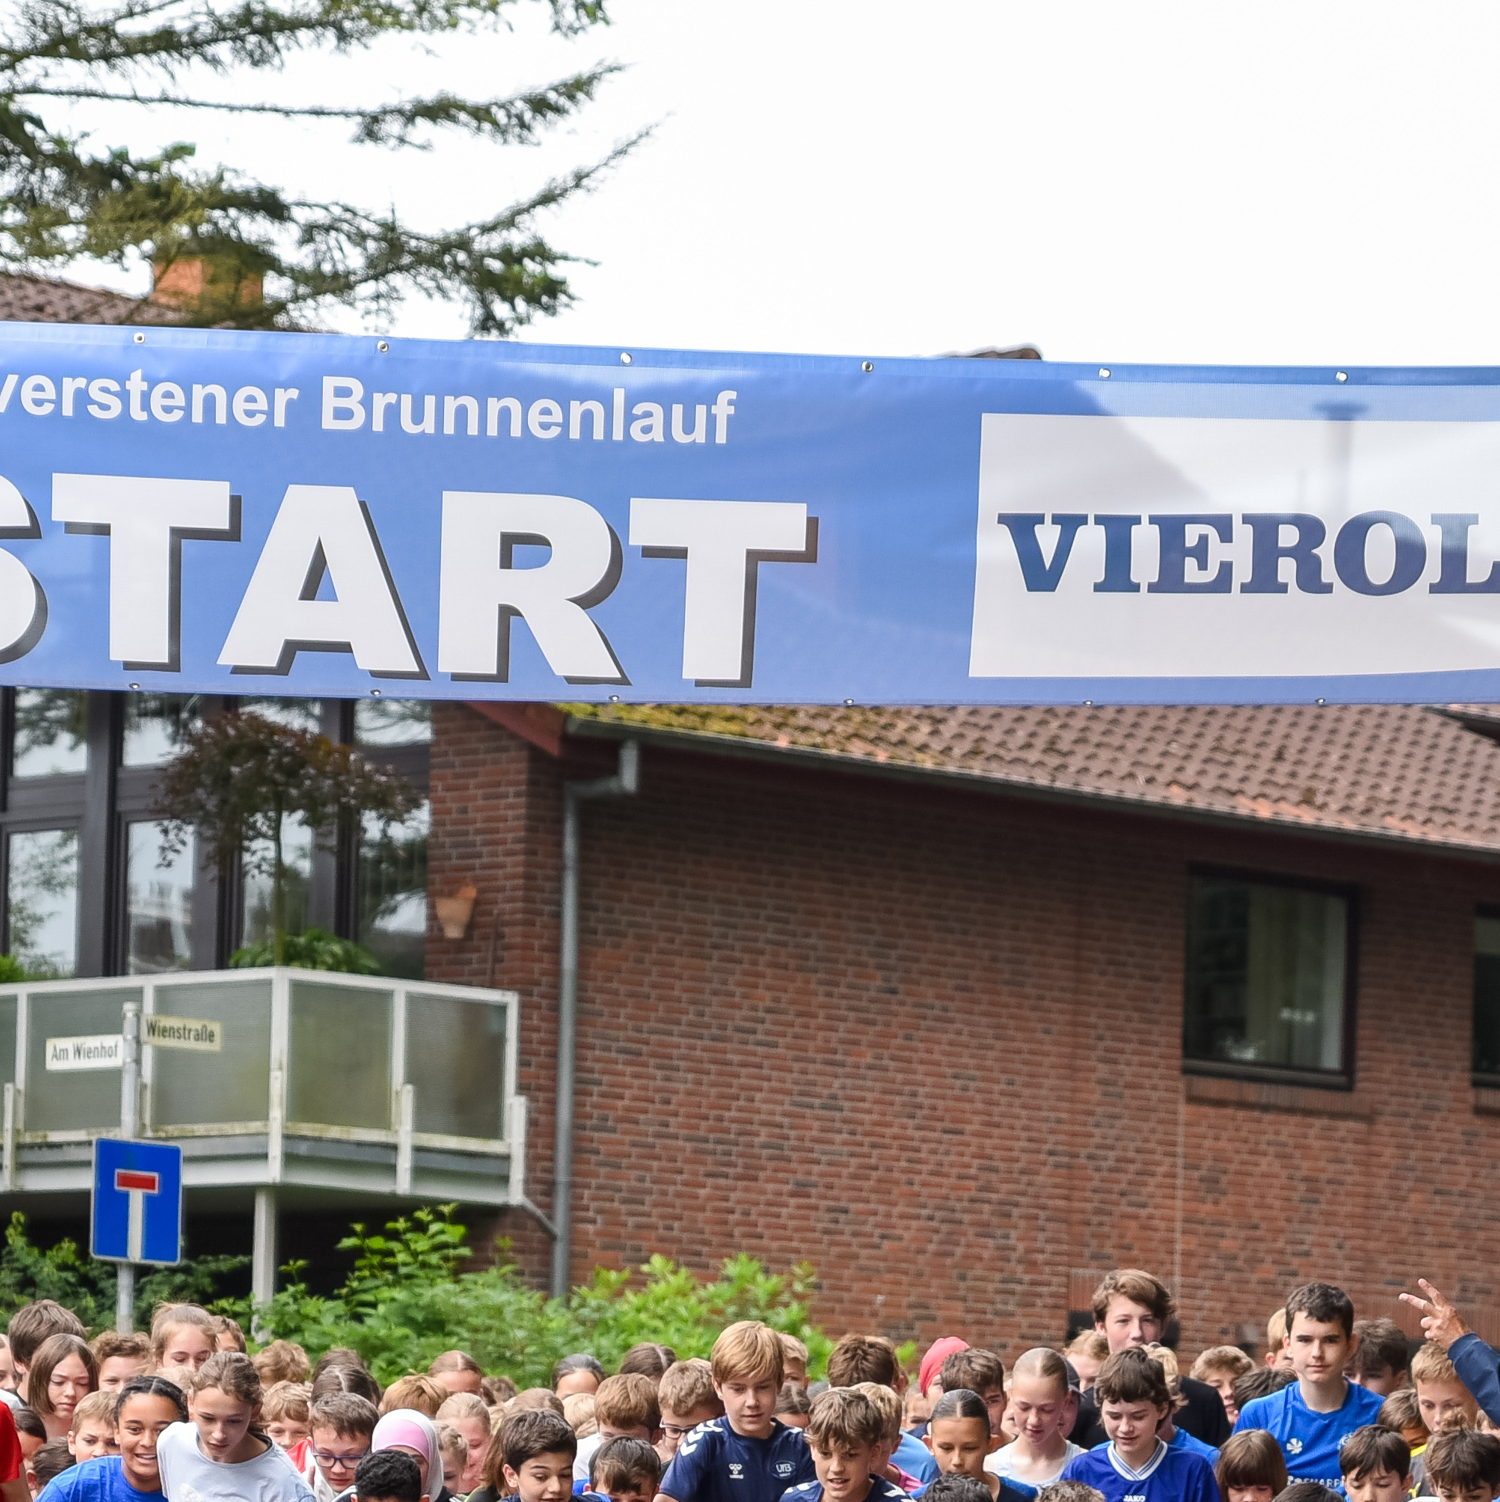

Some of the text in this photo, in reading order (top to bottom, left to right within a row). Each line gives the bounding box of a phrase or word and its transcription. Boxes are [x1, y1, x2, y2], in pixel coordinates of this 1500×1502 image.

[320, 375, 737, 444] Brunnenlauf
[146, 1019, 216, 1043] Wienstraße
[51, 1043, 120, 1062] Am Wienhof
[1123, 1494, 1146, 1502] JAKO
